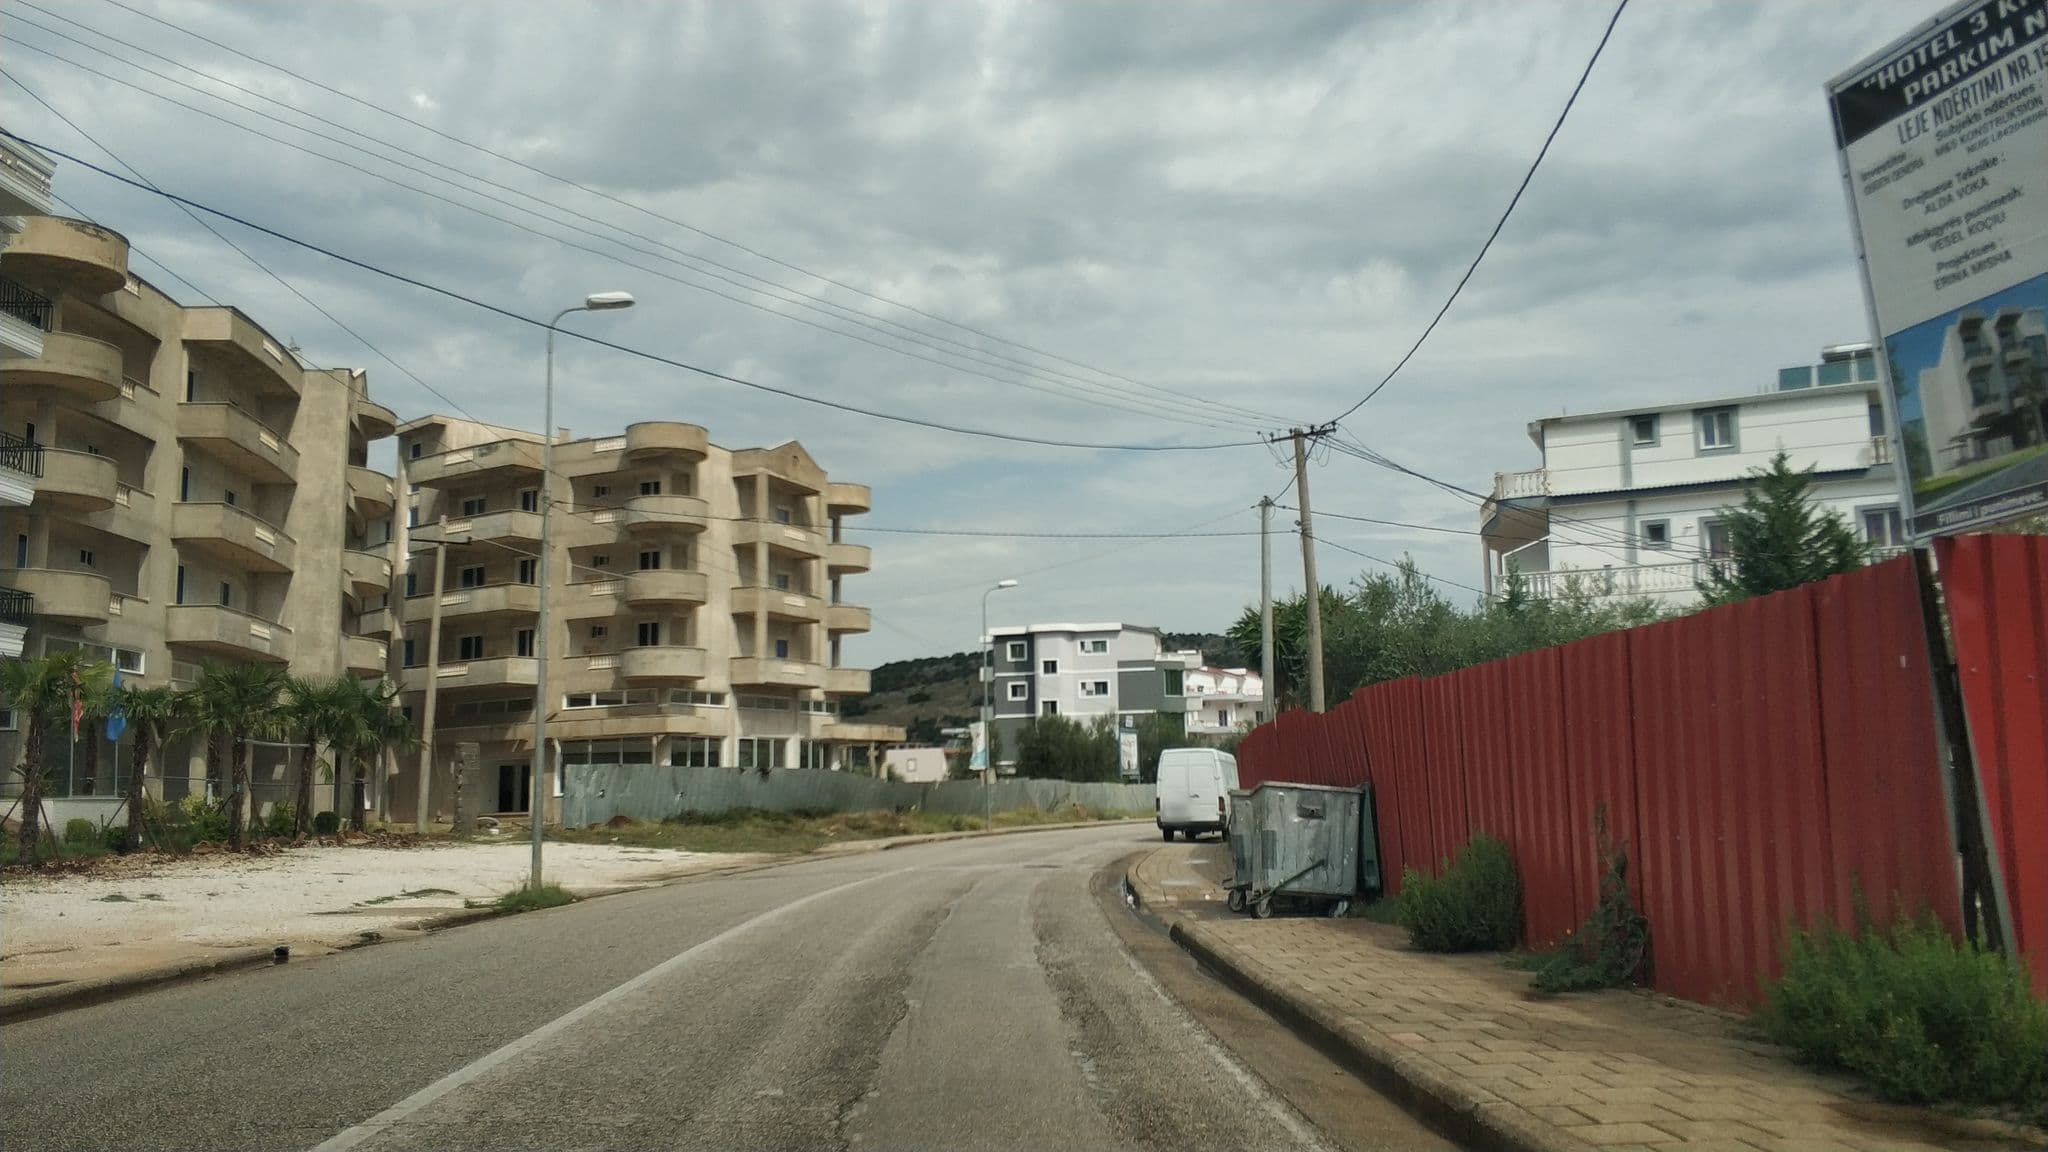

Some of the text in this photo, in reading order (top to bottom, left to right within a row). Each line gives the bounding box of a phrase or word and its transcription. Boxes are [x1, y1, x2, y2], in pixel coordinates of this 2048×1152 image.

[1969, 11, 1988, 35] 3
[1903, 27, 2015, 105] PARKIM
[1897, 109, 1930, 145] LEJE
[1932, 68, 2004, 126] NDËRTIMI
